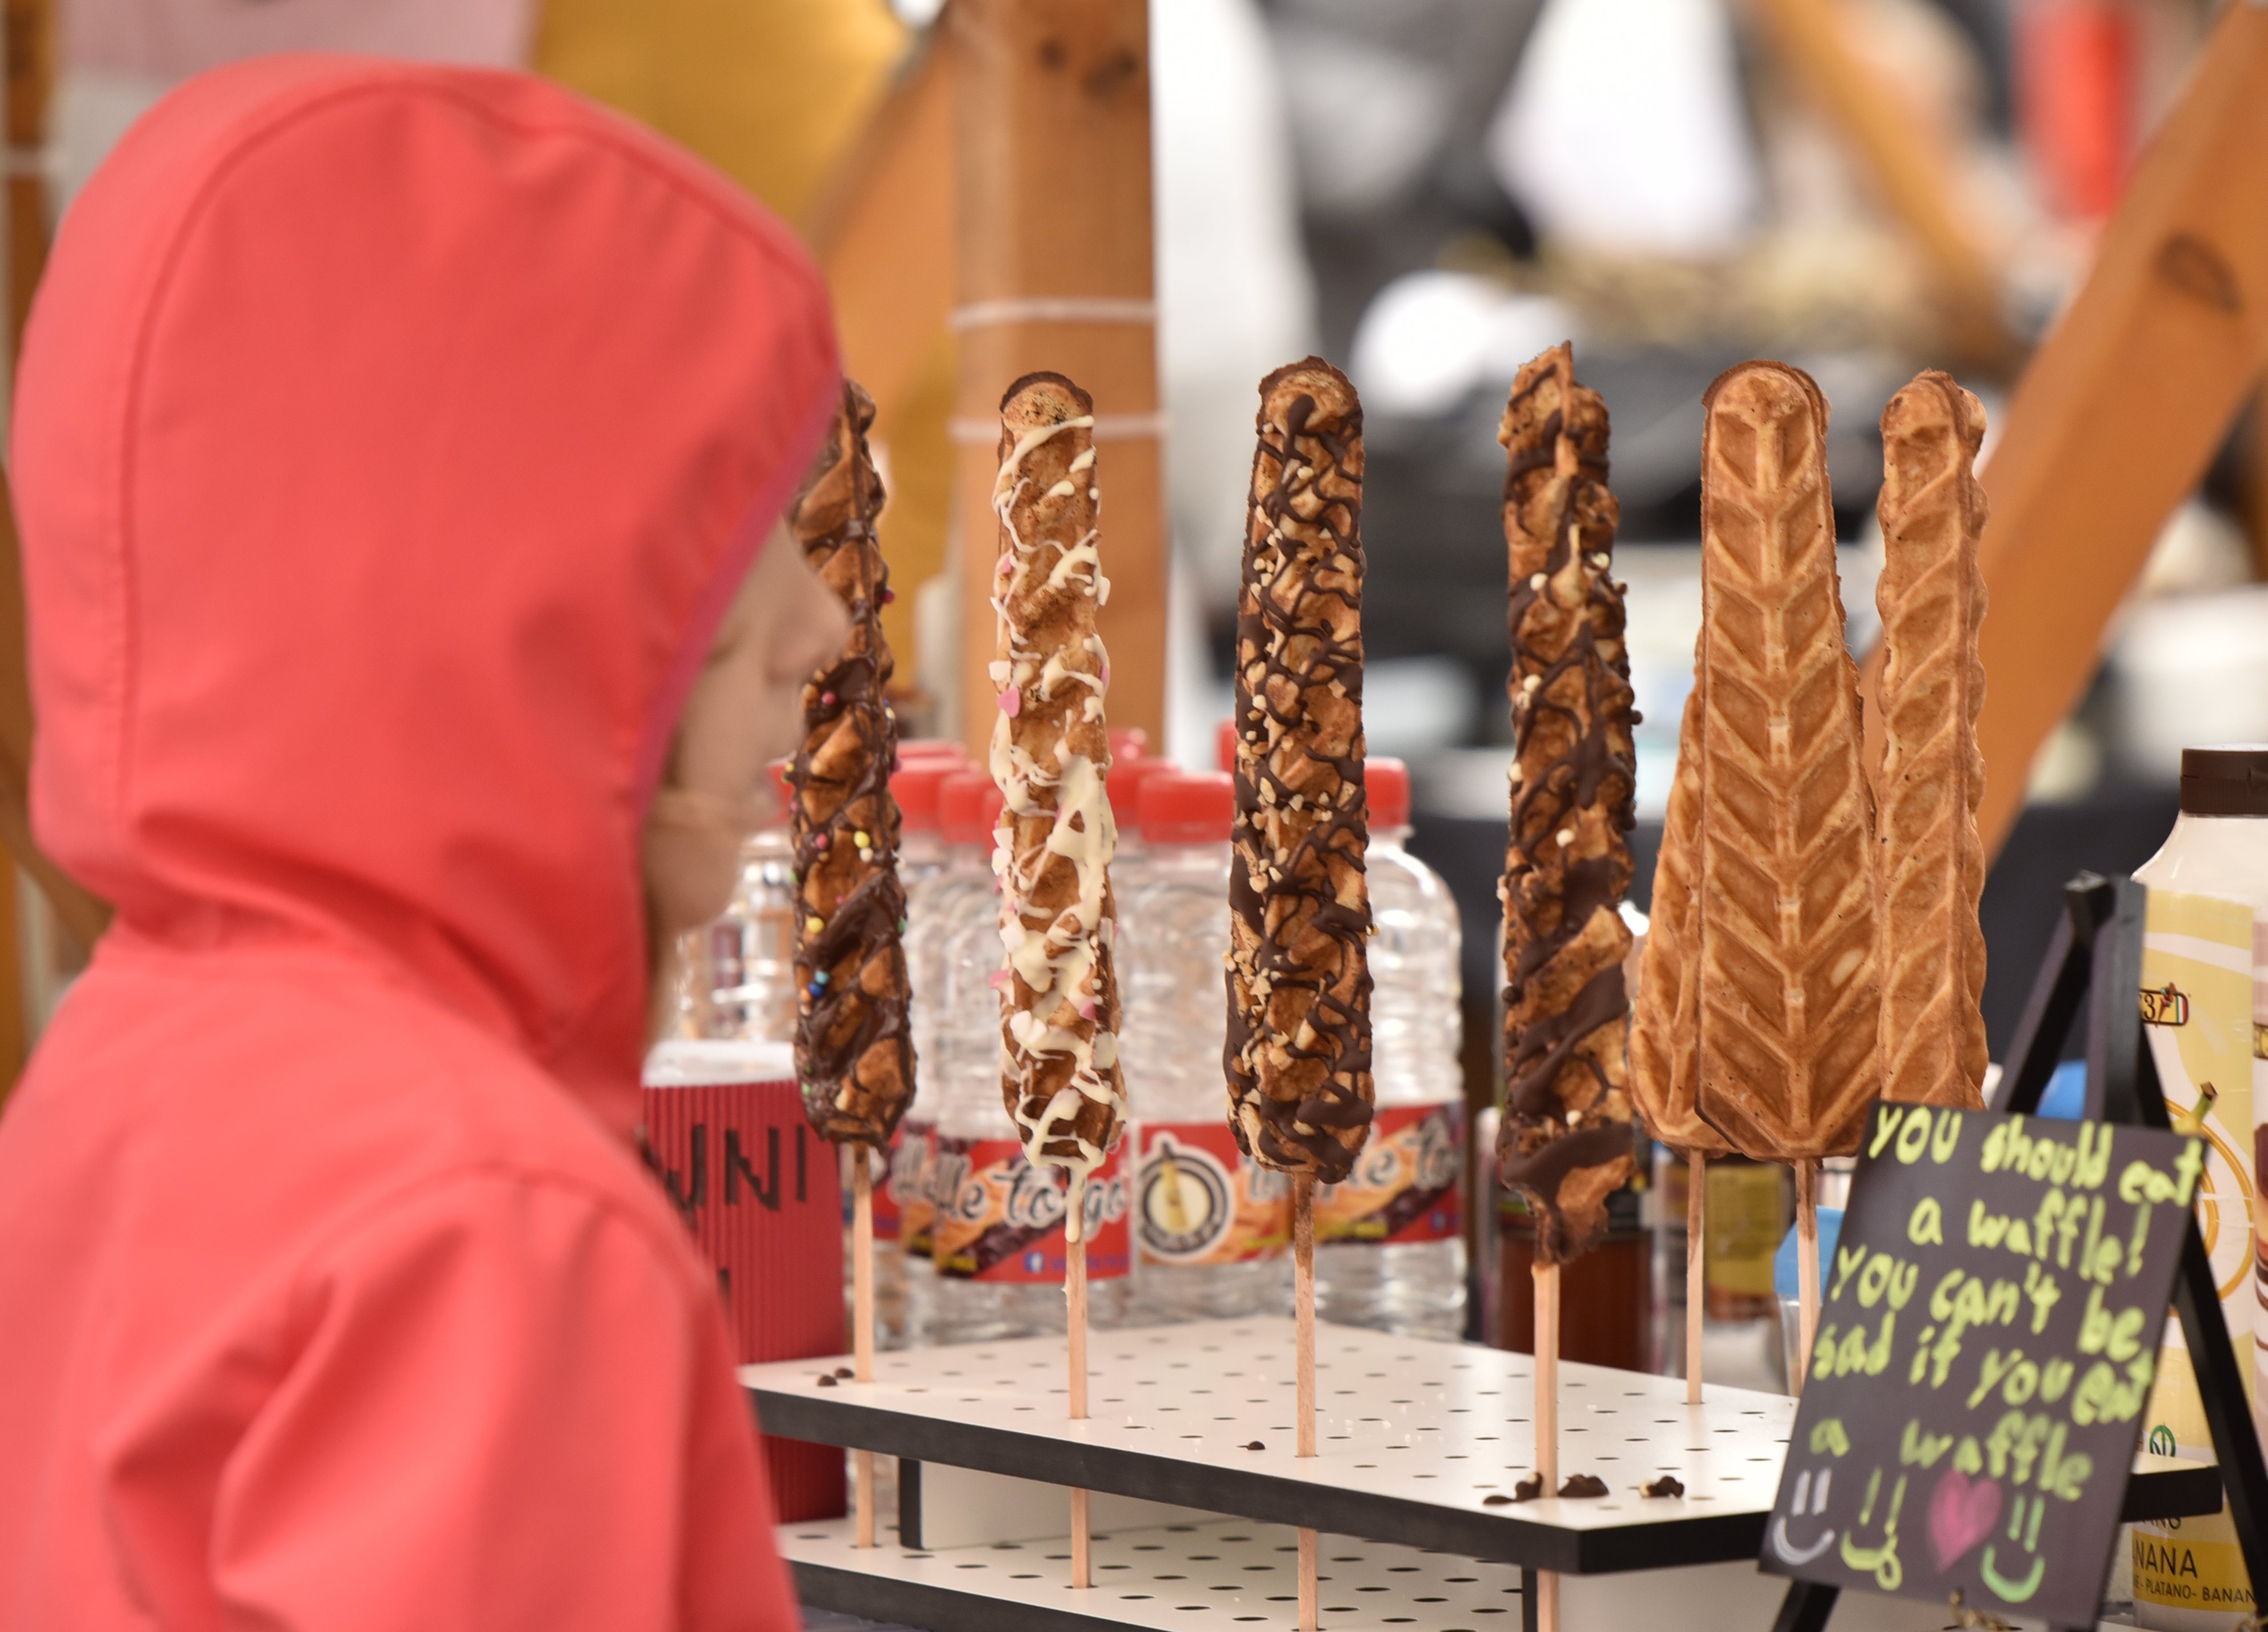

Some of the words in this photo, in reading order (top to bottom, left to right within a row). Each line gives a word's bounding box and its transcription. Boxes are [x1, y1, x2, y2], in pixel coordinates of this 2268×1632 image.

[1980, 1113, 2112, 1189] should
[2119, 1137, 2204, 1207] eat
[1907, 1197, 1942, 1245] a
[1813, 1310, 1895, 1380] sad
[1909, 1313, 1967, 1389] if
[2078, 1286, 2145, 1362] be
[1810, 1418, 1850, 1457] a
[1900, 1409, 2093, 1501] waffle
[2134, 1538, 2198, 1579] NANA
[2202, 1586, 2254, 1603] BANAN
